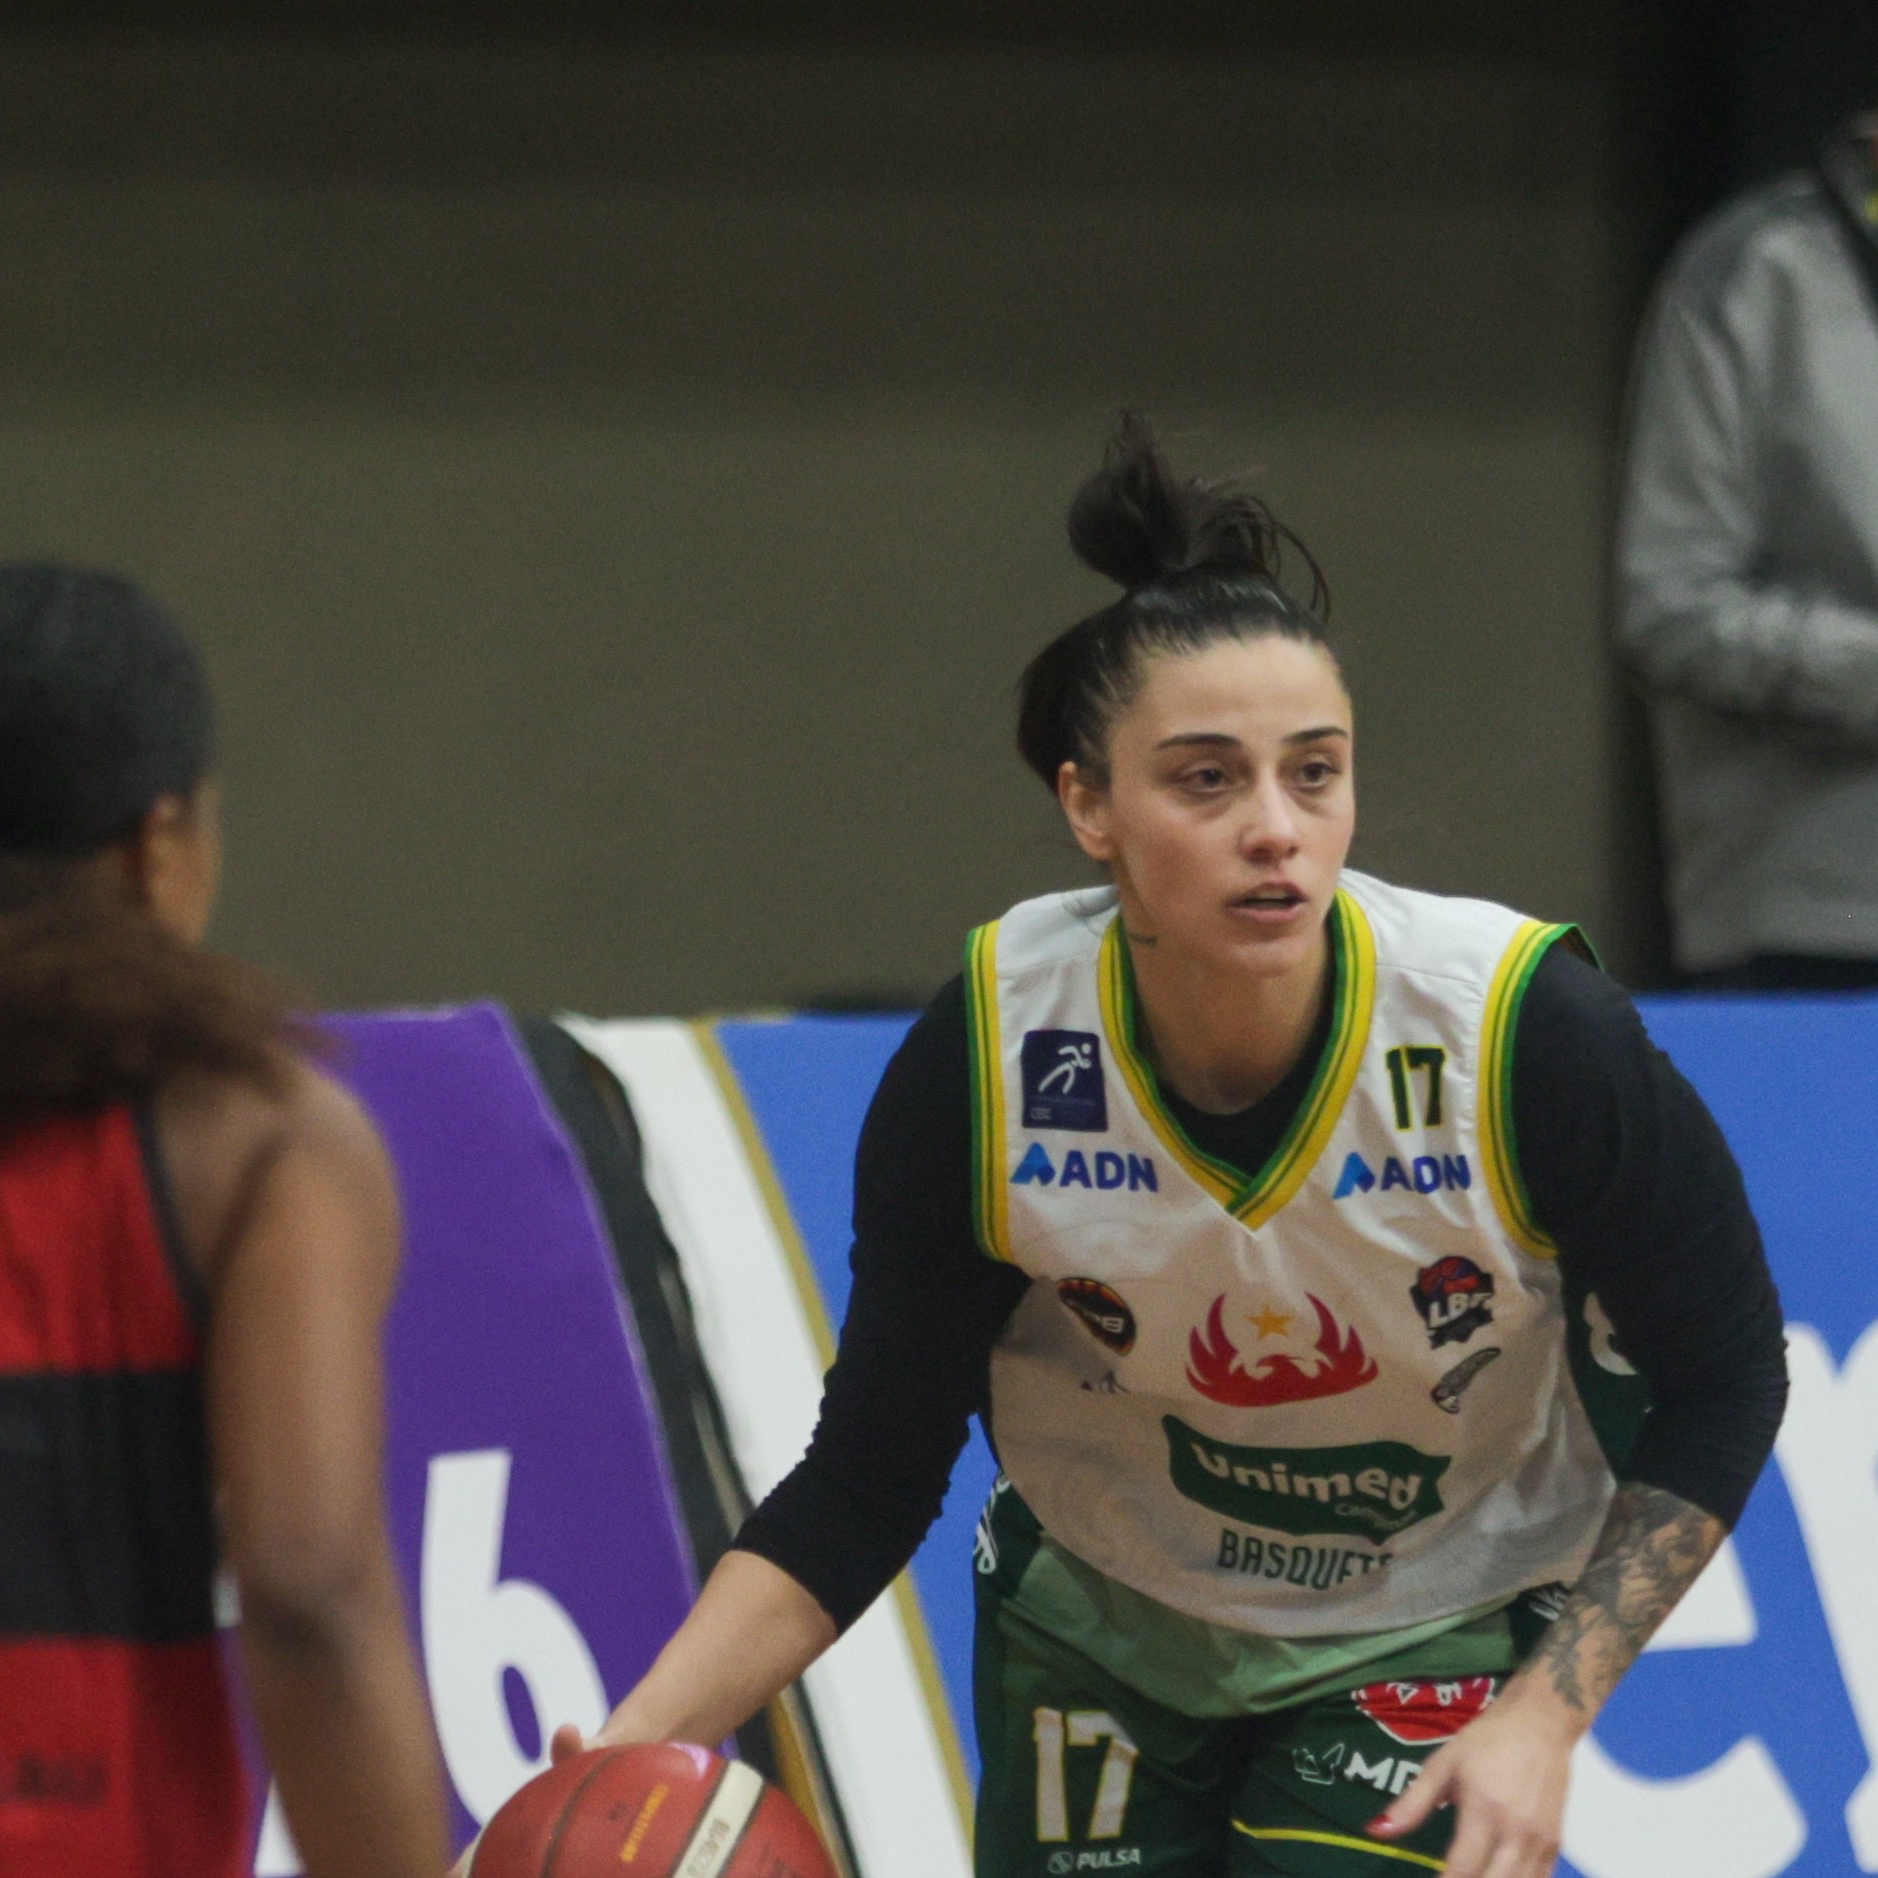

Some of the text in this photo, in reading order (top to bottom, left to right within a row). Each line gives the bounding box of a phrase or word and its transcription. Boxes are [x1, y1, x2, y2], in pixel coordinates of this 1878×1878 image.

[1385, 1044, 1446, 1132] 17
[1059, 1150, 1158, 1192] ADN
[1380, 1155, 1471, 1194] ADN
[1190, 1443, 1421, 1511] Unimed
[1032, 1706, 1141, 1843] 17
